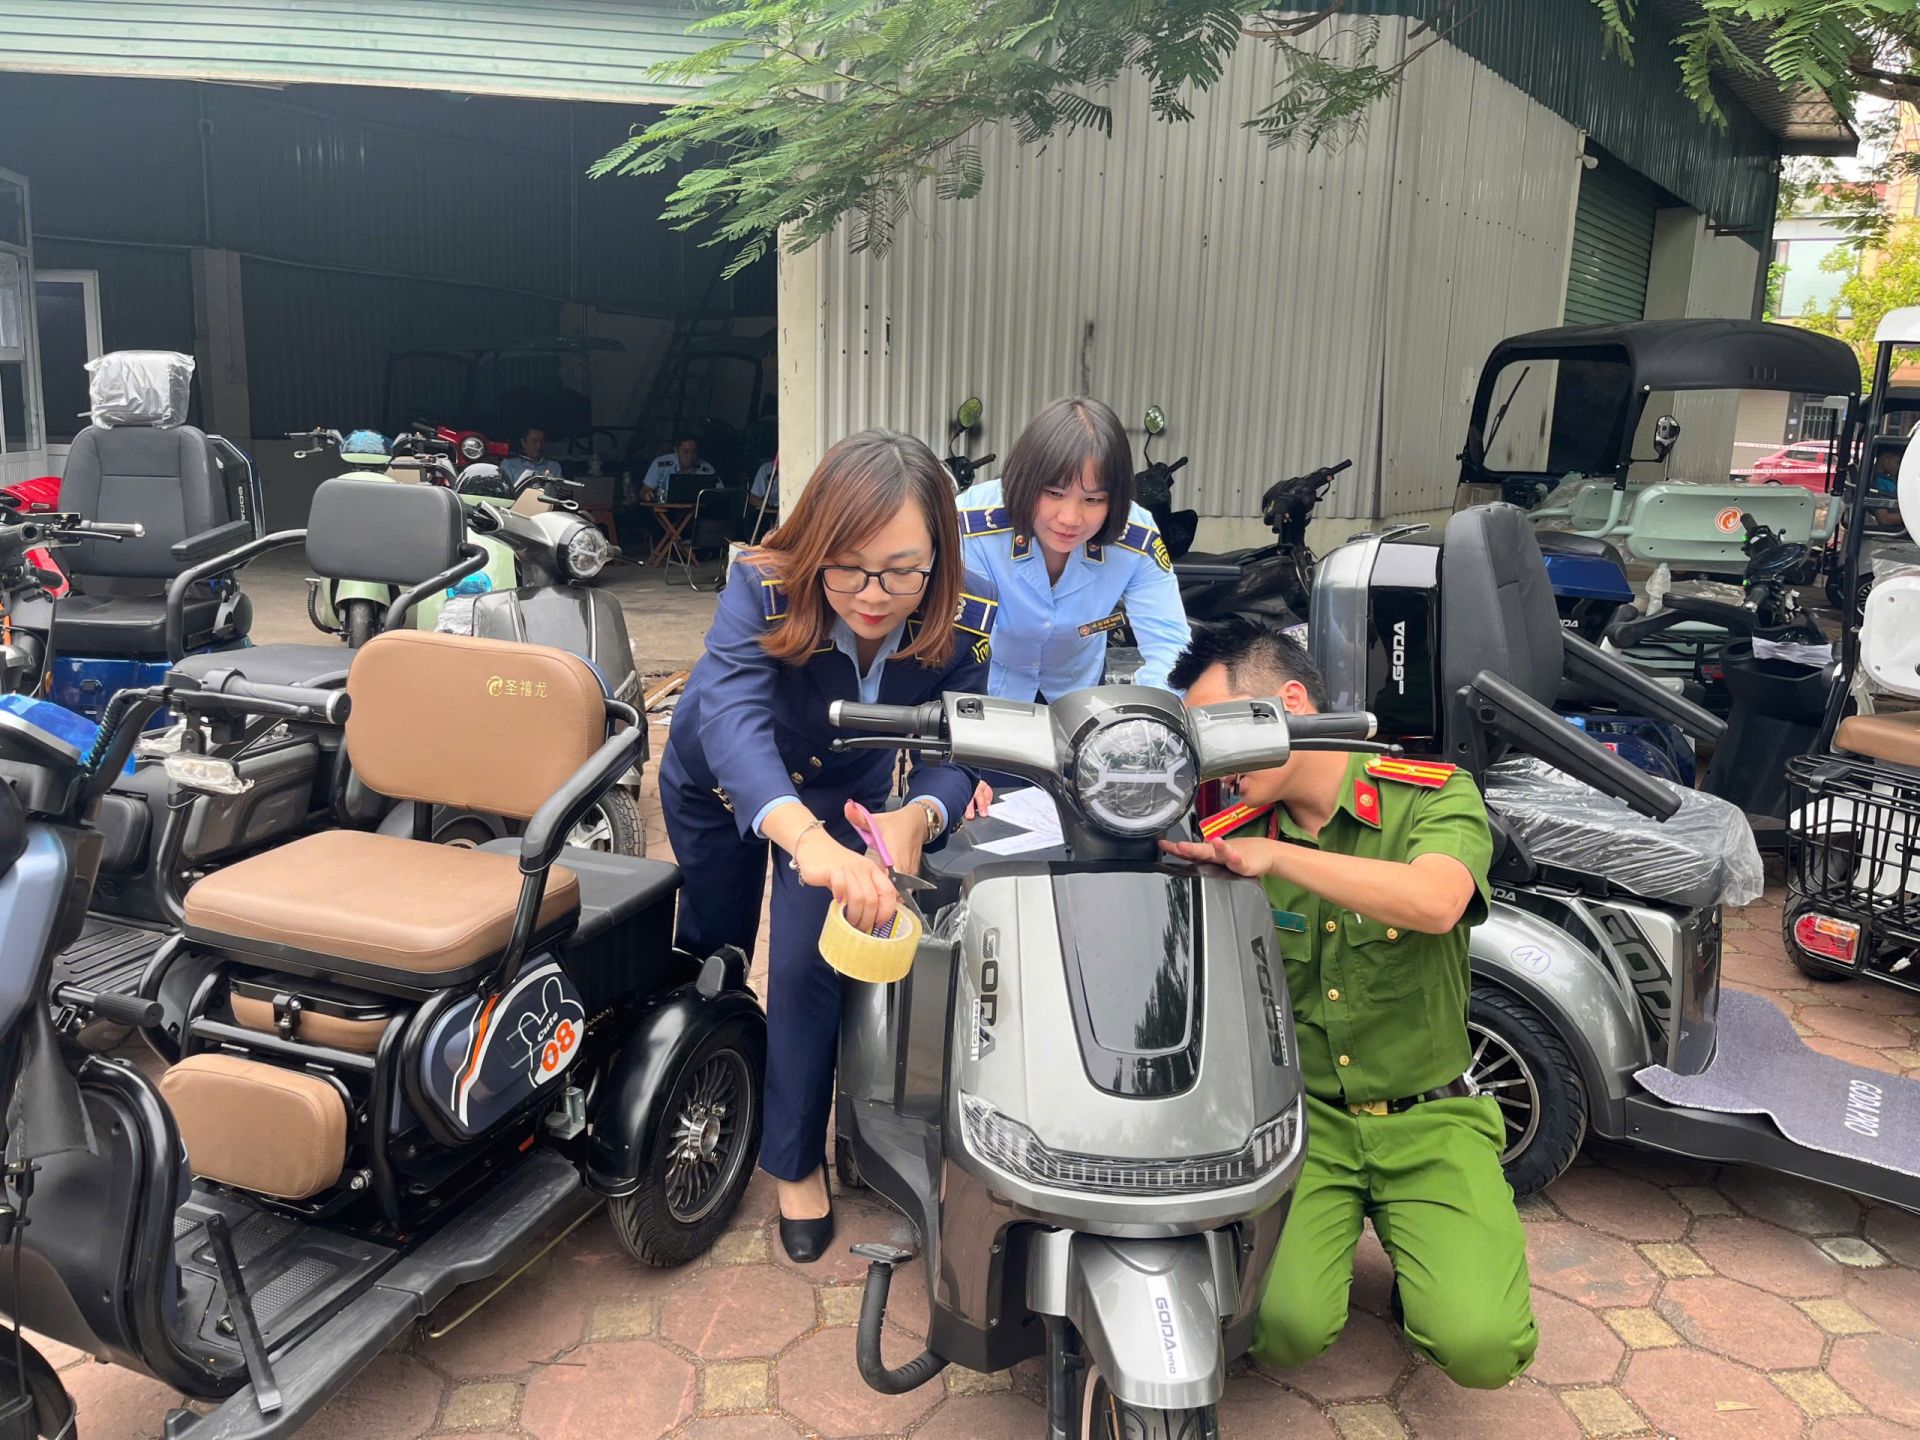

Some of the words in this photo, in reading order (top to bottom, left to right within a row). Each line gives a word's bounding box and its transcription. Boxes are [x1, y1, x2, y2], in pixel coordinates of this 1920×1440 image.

[1560, 618, 1579, 628] DA
[1392, 620, 1406, 681] GODA
[1490, 886, 1516, 902] DA
[979, 927, 1001, 1061] GODA
[1250, 935, 1284, 1067] GODA
[537, 1012, 558, 1041] Cute
[540, 1018, 576, 1072] 08
[1847, 1079, 1882, 1114] GODA
[1844, 1106, 1880, 1137] PRO
[1155, 1297, 1177, 1351] GODA
[1167, 1351, 1177, 1375] PRO
